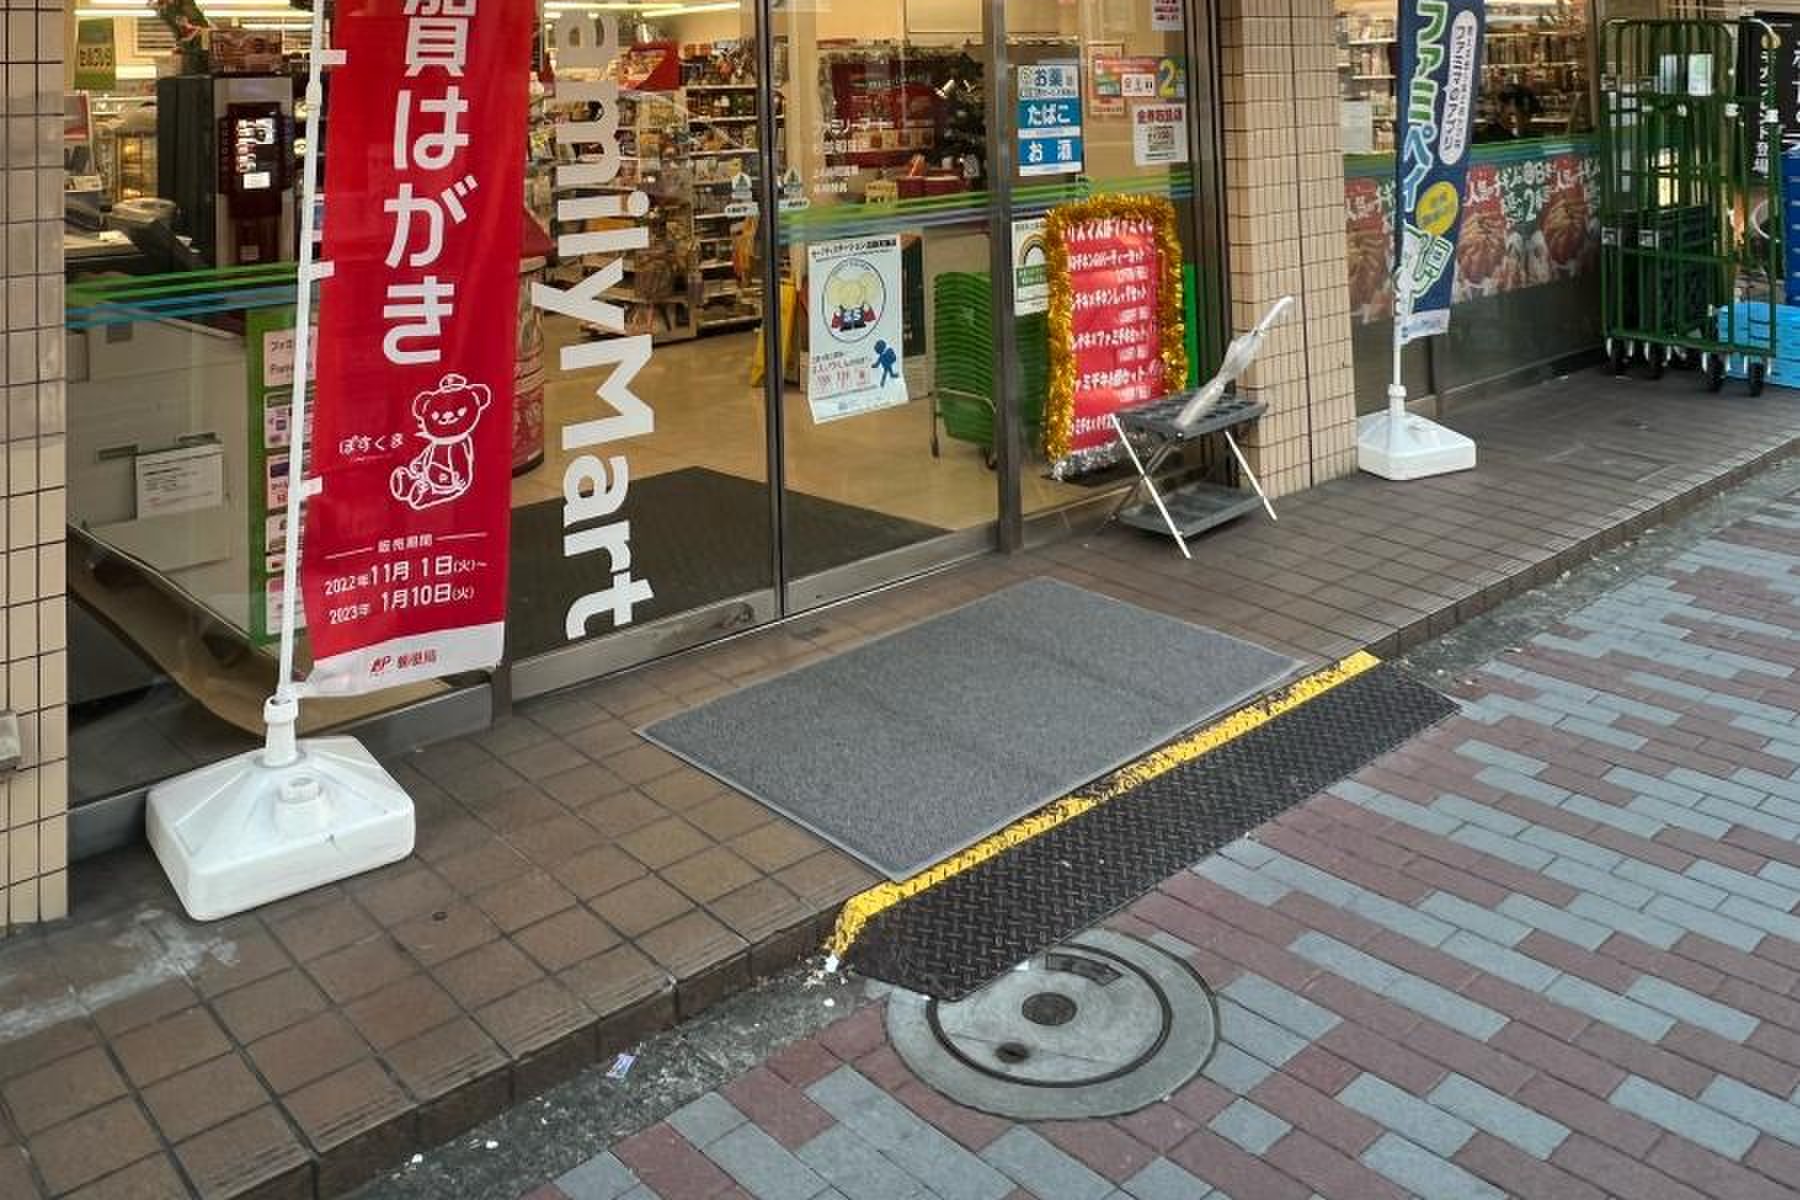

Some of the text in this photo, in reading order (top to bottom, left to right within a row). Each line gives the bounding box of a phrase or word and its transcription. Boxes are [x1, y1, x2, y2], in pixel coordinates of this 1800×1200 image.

[1027, 103, 1072, 126] たばこ
[1028, 140, 1073, 162] お酒
